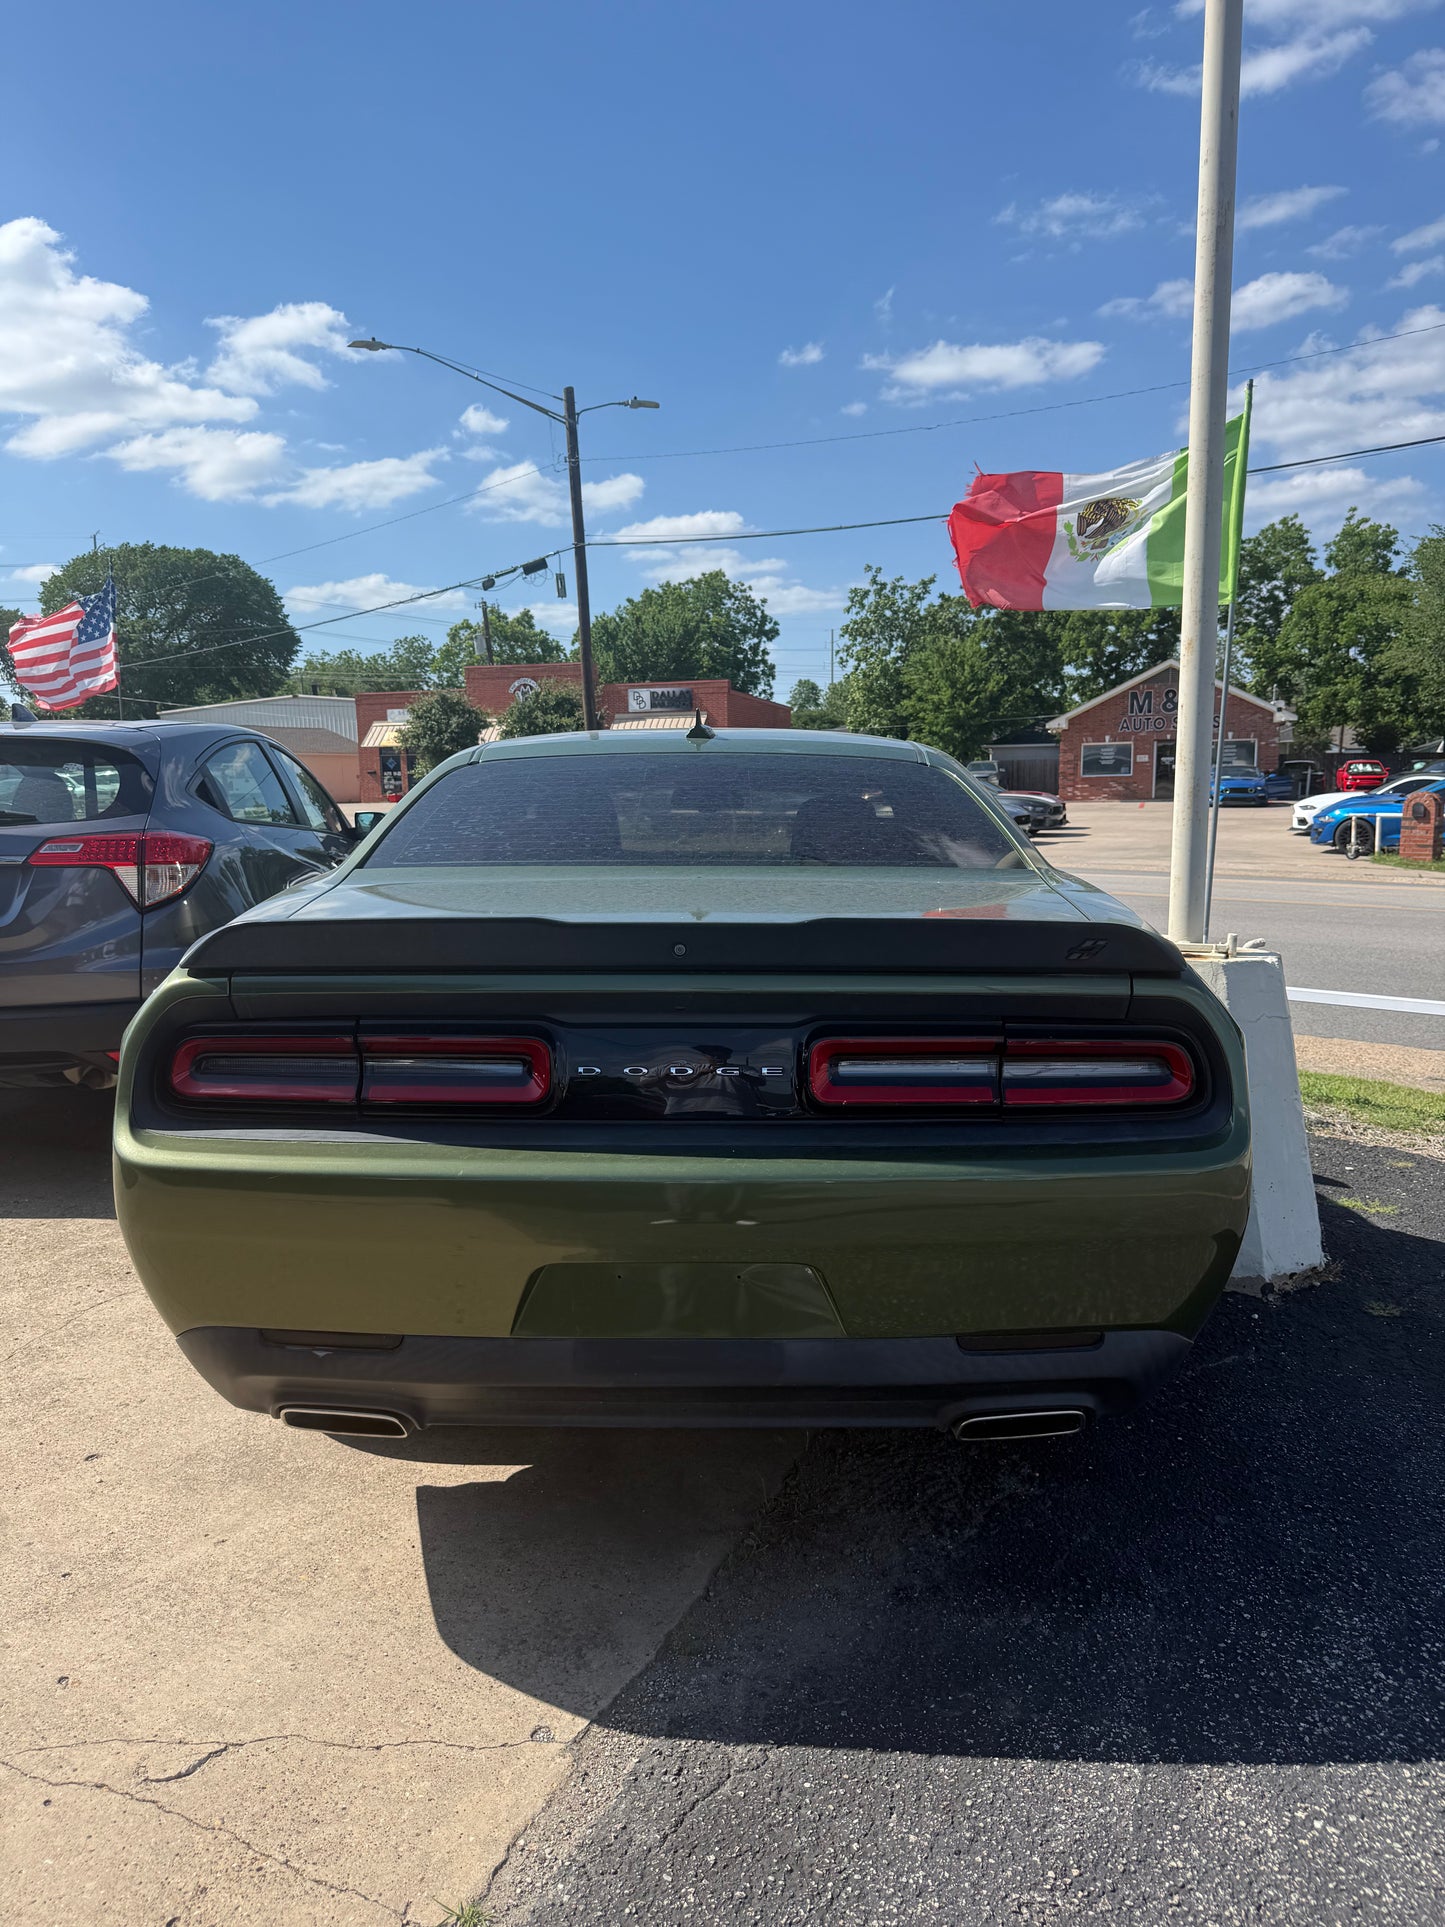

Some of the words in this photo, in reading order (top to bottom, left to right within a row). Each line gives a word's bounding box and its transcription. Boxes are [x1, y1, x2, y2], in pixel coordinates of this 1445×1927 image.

[1128, 690, 1153, 716] M
[1161, 688, 1178, 714] &
[1119, 716, 1166, 732] AUTO
[578, 1066, 784, 1076] DODGE
